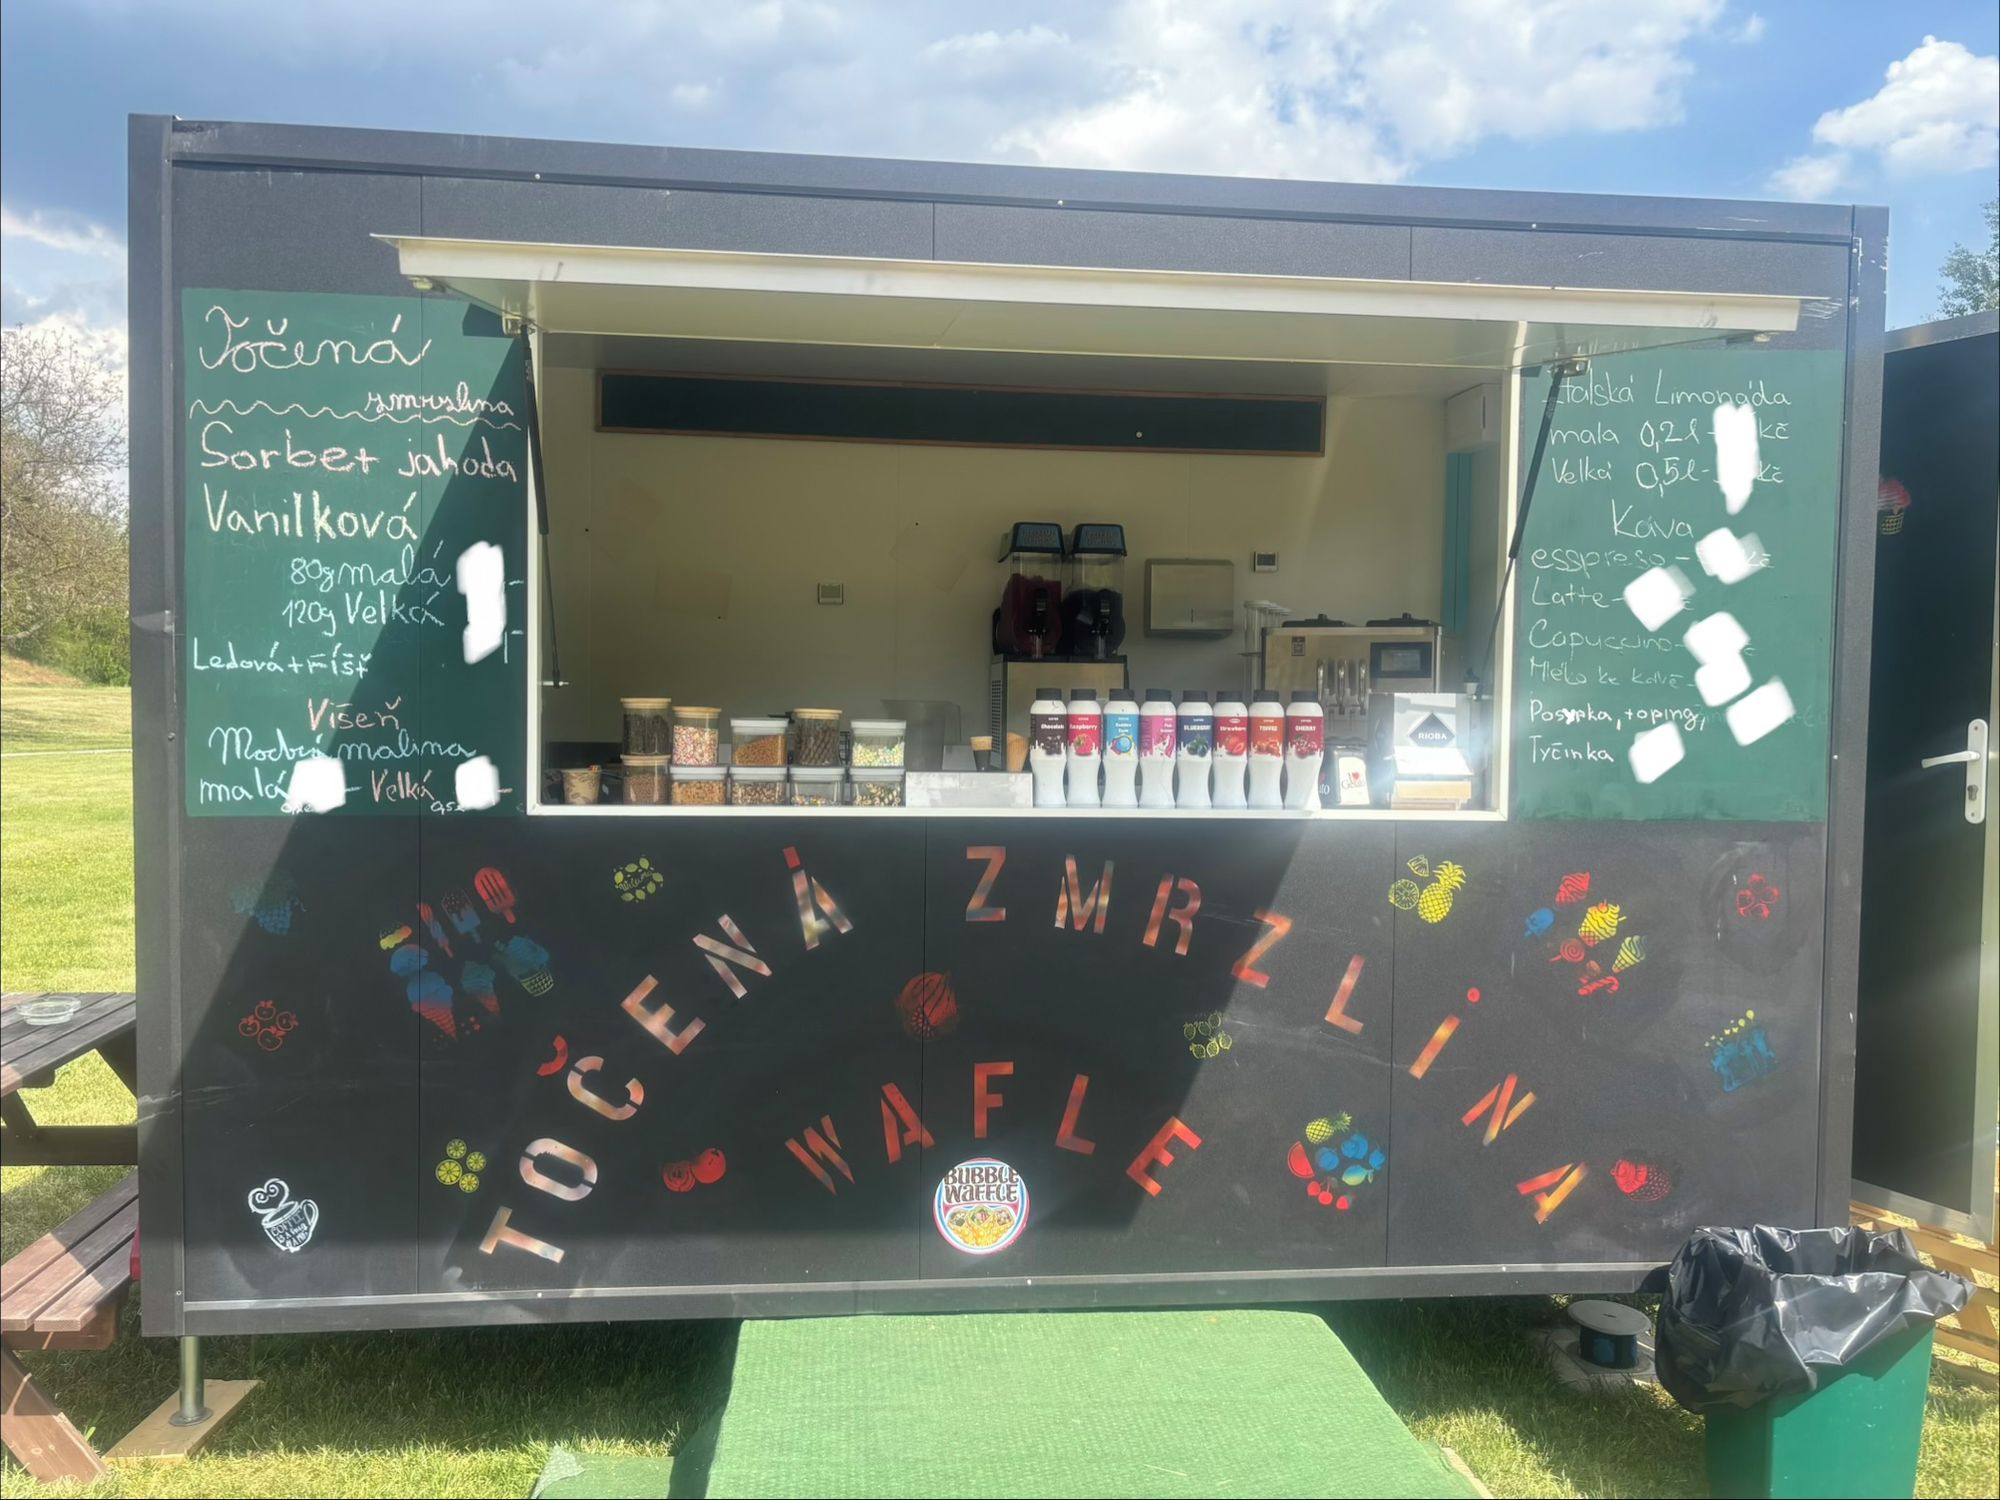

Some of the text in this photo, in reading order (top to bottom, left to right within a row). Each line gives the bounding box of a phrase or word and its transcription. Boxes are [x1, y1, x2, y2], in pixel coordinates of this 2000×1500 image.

[1655, 369, 1791, 406] Limonáda
[201, 421, 517, 482] Sorbet jahoda
[1552, 456, 1613, 485] Velká
[204, 483, 418, 543] Vanilková
[1611, 498, 1695, 539] Káva
[290, 541, 451, 593] 80g malá
[282, 599, 337, 637] 120g
[193, 637, 284, 672] Ledová
[337, 728, 477, 760] malina
[1418, 732, 1448, 741] RIOBA
[1529, 735, 1615, 764] Tyčinka
[479, 846, 854, 1264] TOČENÁ
[784, 1061, 1204, 1198] WAFLE
[943, 1165, 1020, 1185] BUBBLE
